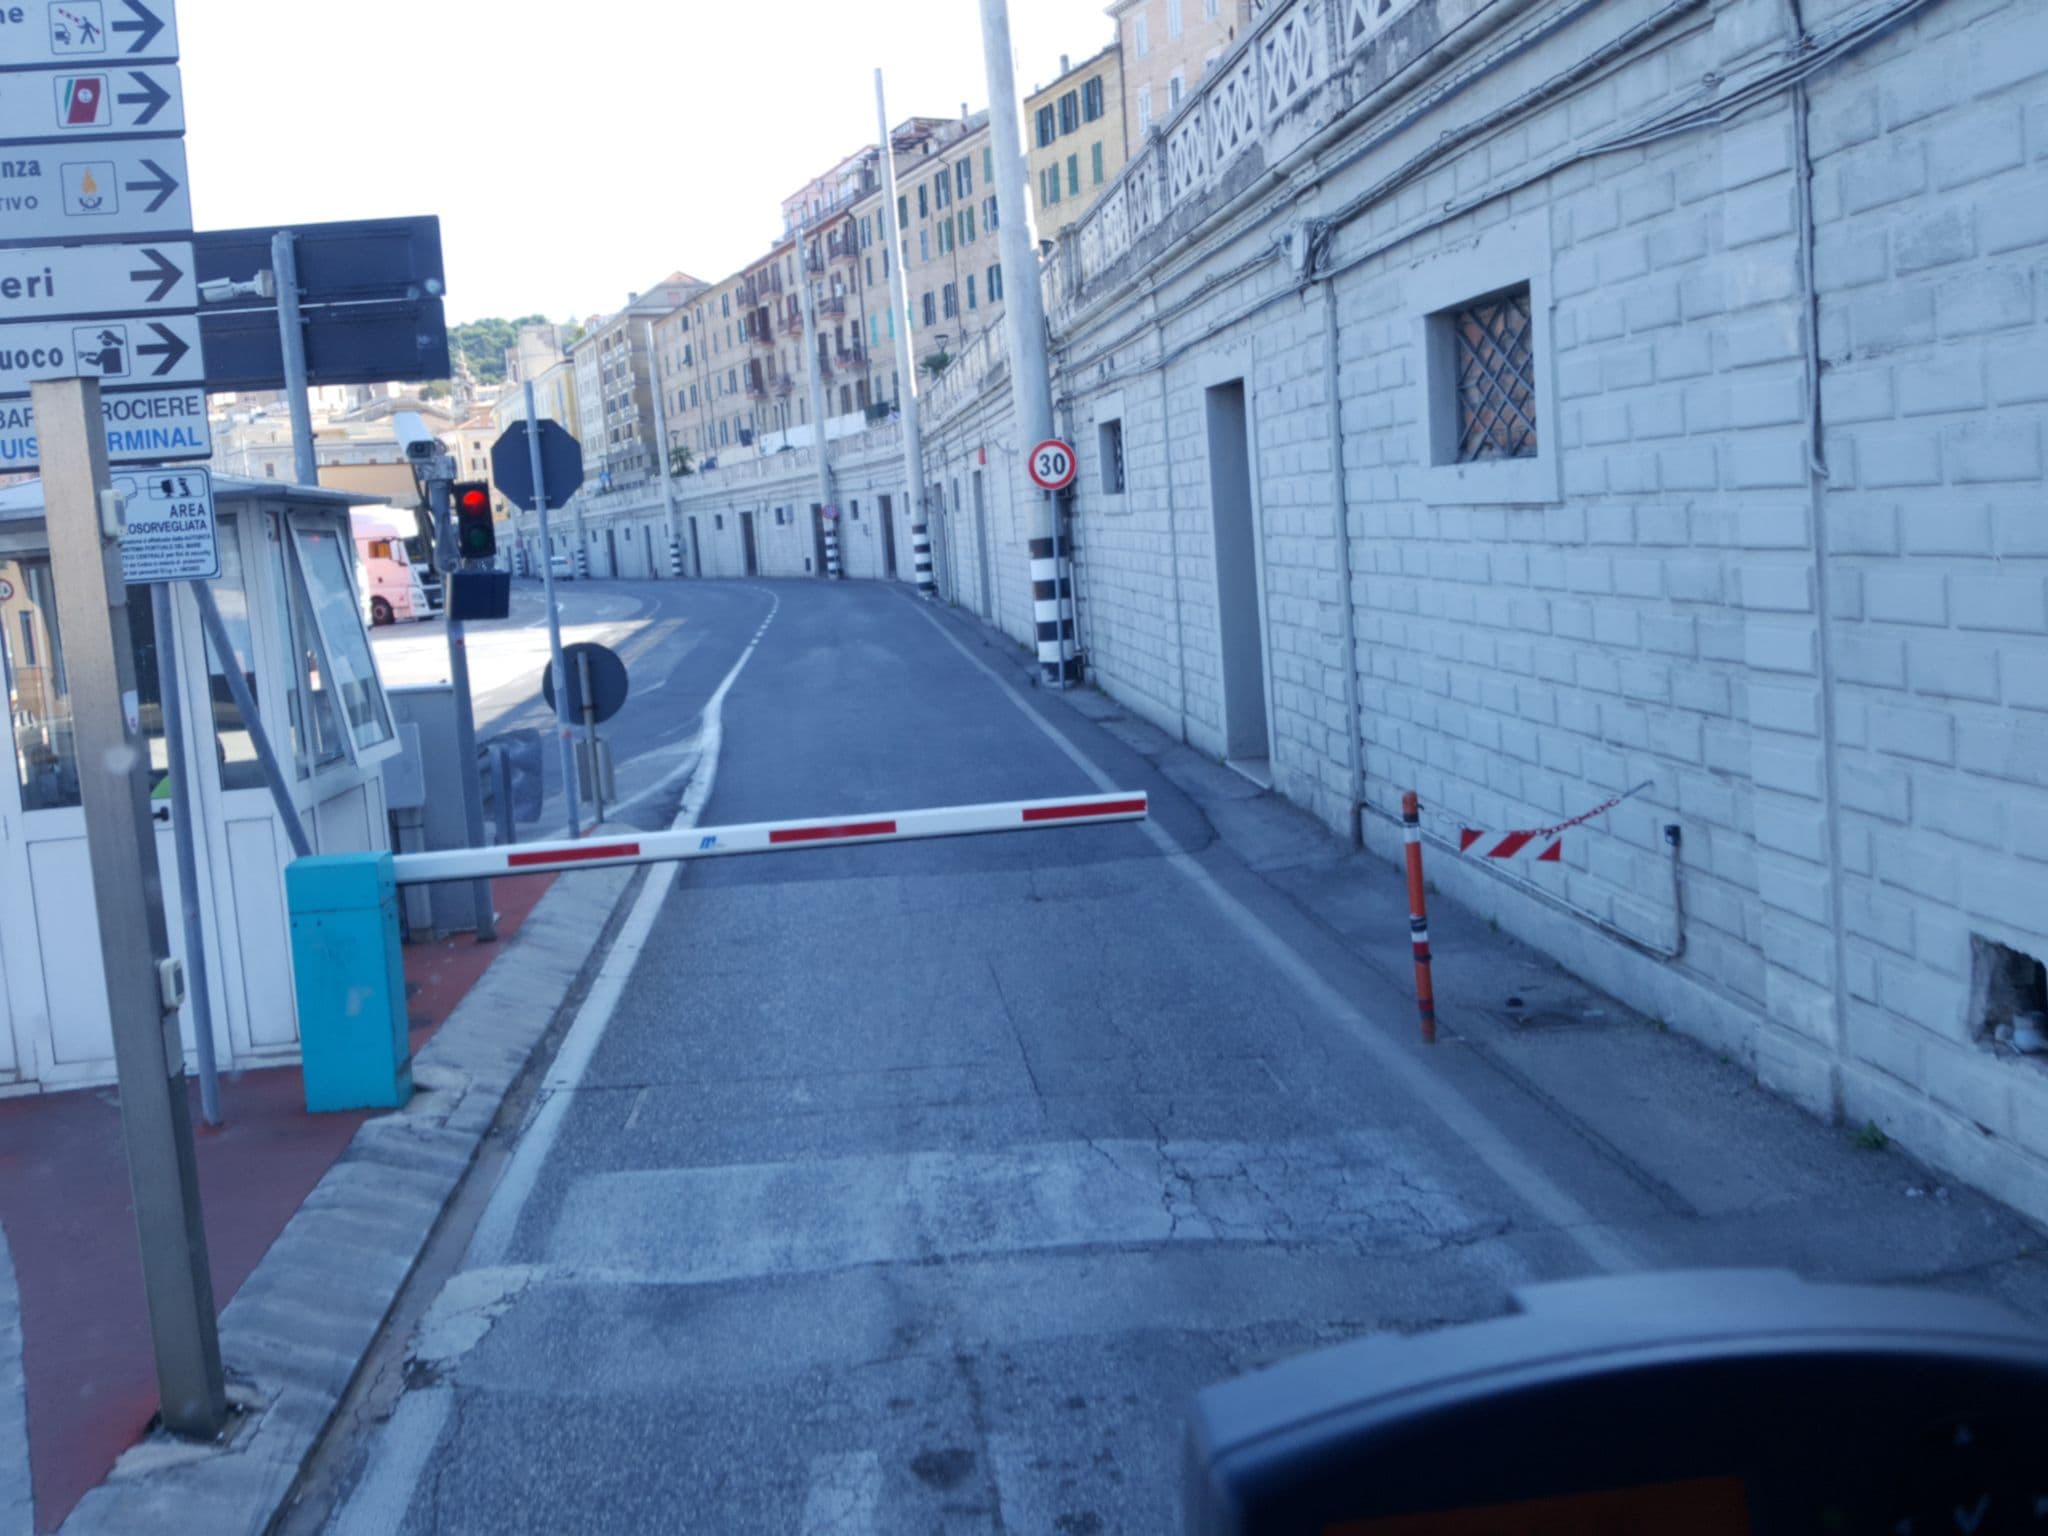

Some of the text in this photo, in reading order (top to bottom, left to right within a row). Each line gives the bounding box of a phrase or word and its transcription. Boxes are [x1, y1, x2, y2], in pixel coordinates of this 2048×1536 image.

[1, 160, 42, 178] nza
[0, 267, 54, 299] eri
[0, 347, 64, 370] uoco
[101, 395, 201, 421] ROCIERE
[107, 426, 203, 452] RMINAL
[1040, 452, 1066, 477] 30
[169, 503, 206, 518] AREA
[127, 520, 207, 535] OSORVEGLIATA
